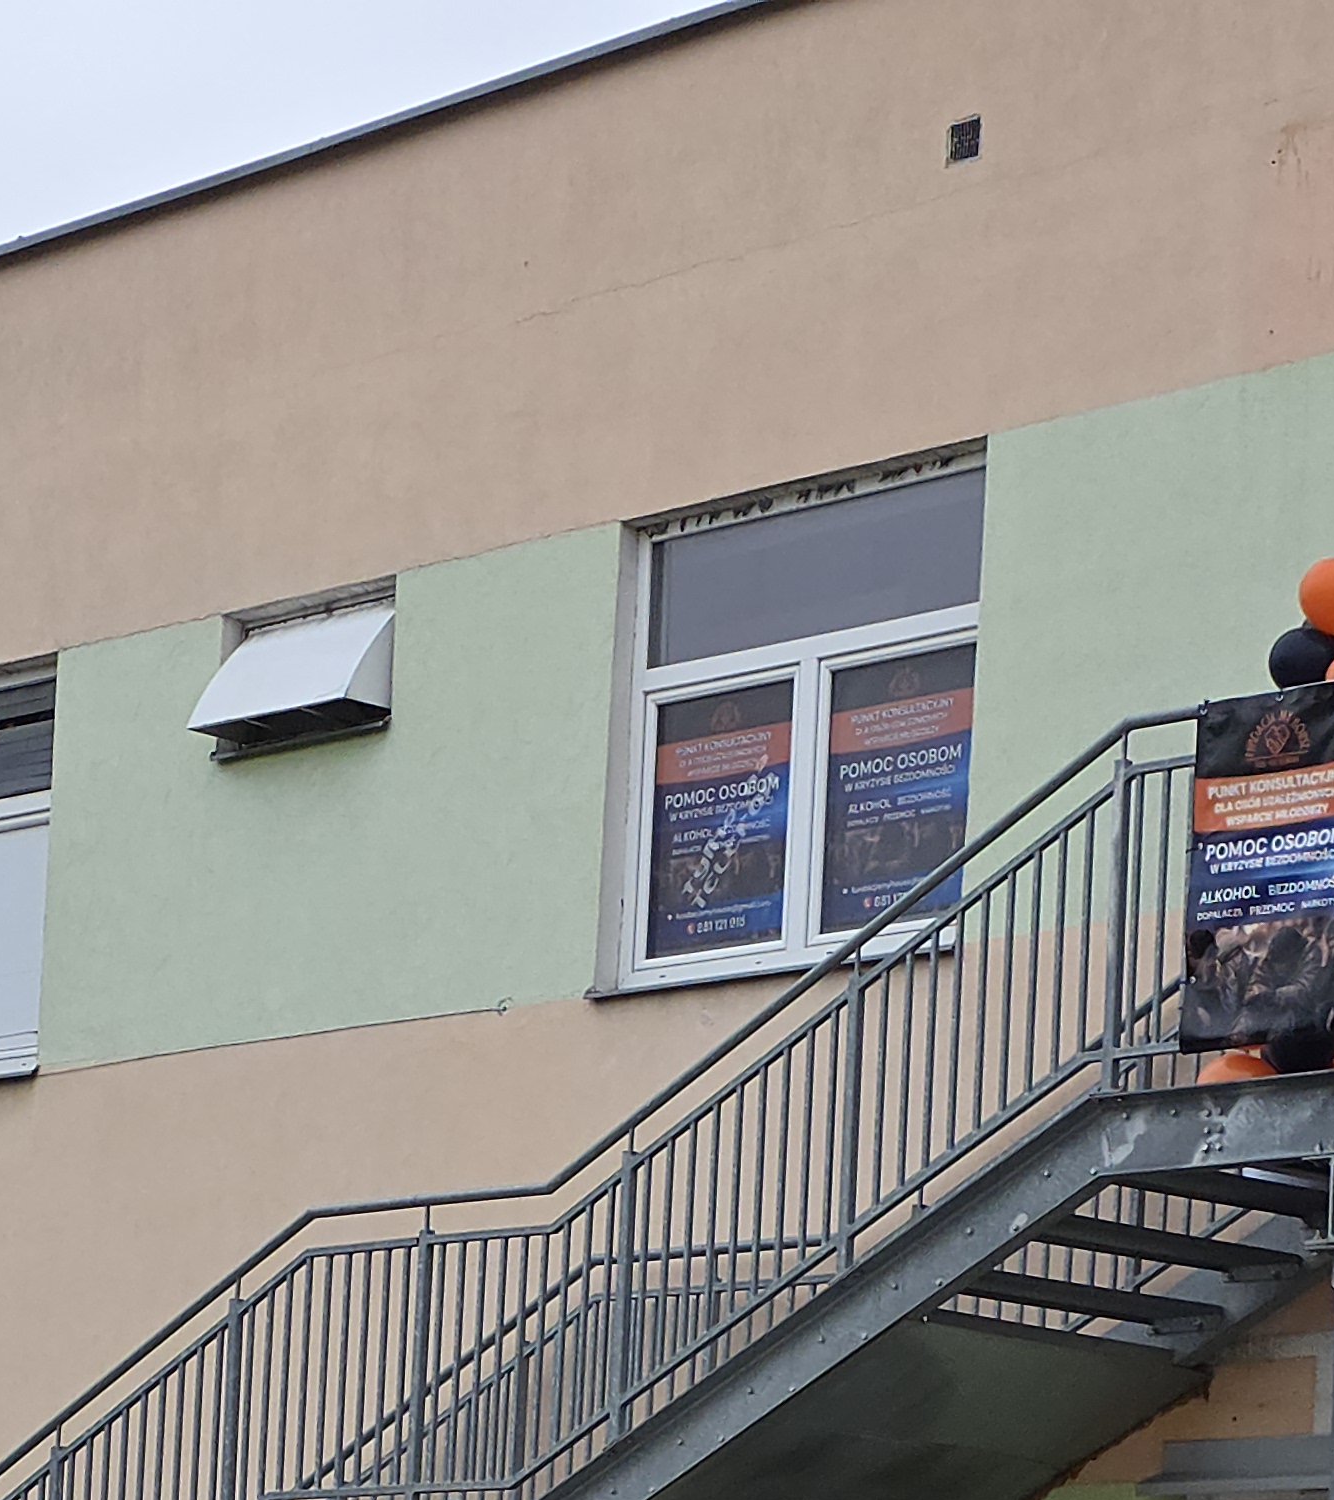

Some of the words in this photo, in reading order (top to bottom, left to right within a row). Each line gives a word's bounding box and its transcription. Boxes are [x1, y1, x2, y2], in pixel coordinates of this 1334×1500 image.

[839, 756, 894, 781] POMOC
[897, 743, 963, 769] OSOBOM
[664, 788, 716, 811] POMOC
[718, 775, 780, 800] OSOBOM
[1207, 782, 1247, 800] PUNKT
[1205, 837, 1268, 862] POMOC
[1210, 864, 1220, 874] W
[1198, 885, 1261, 905] ALKOHOL
